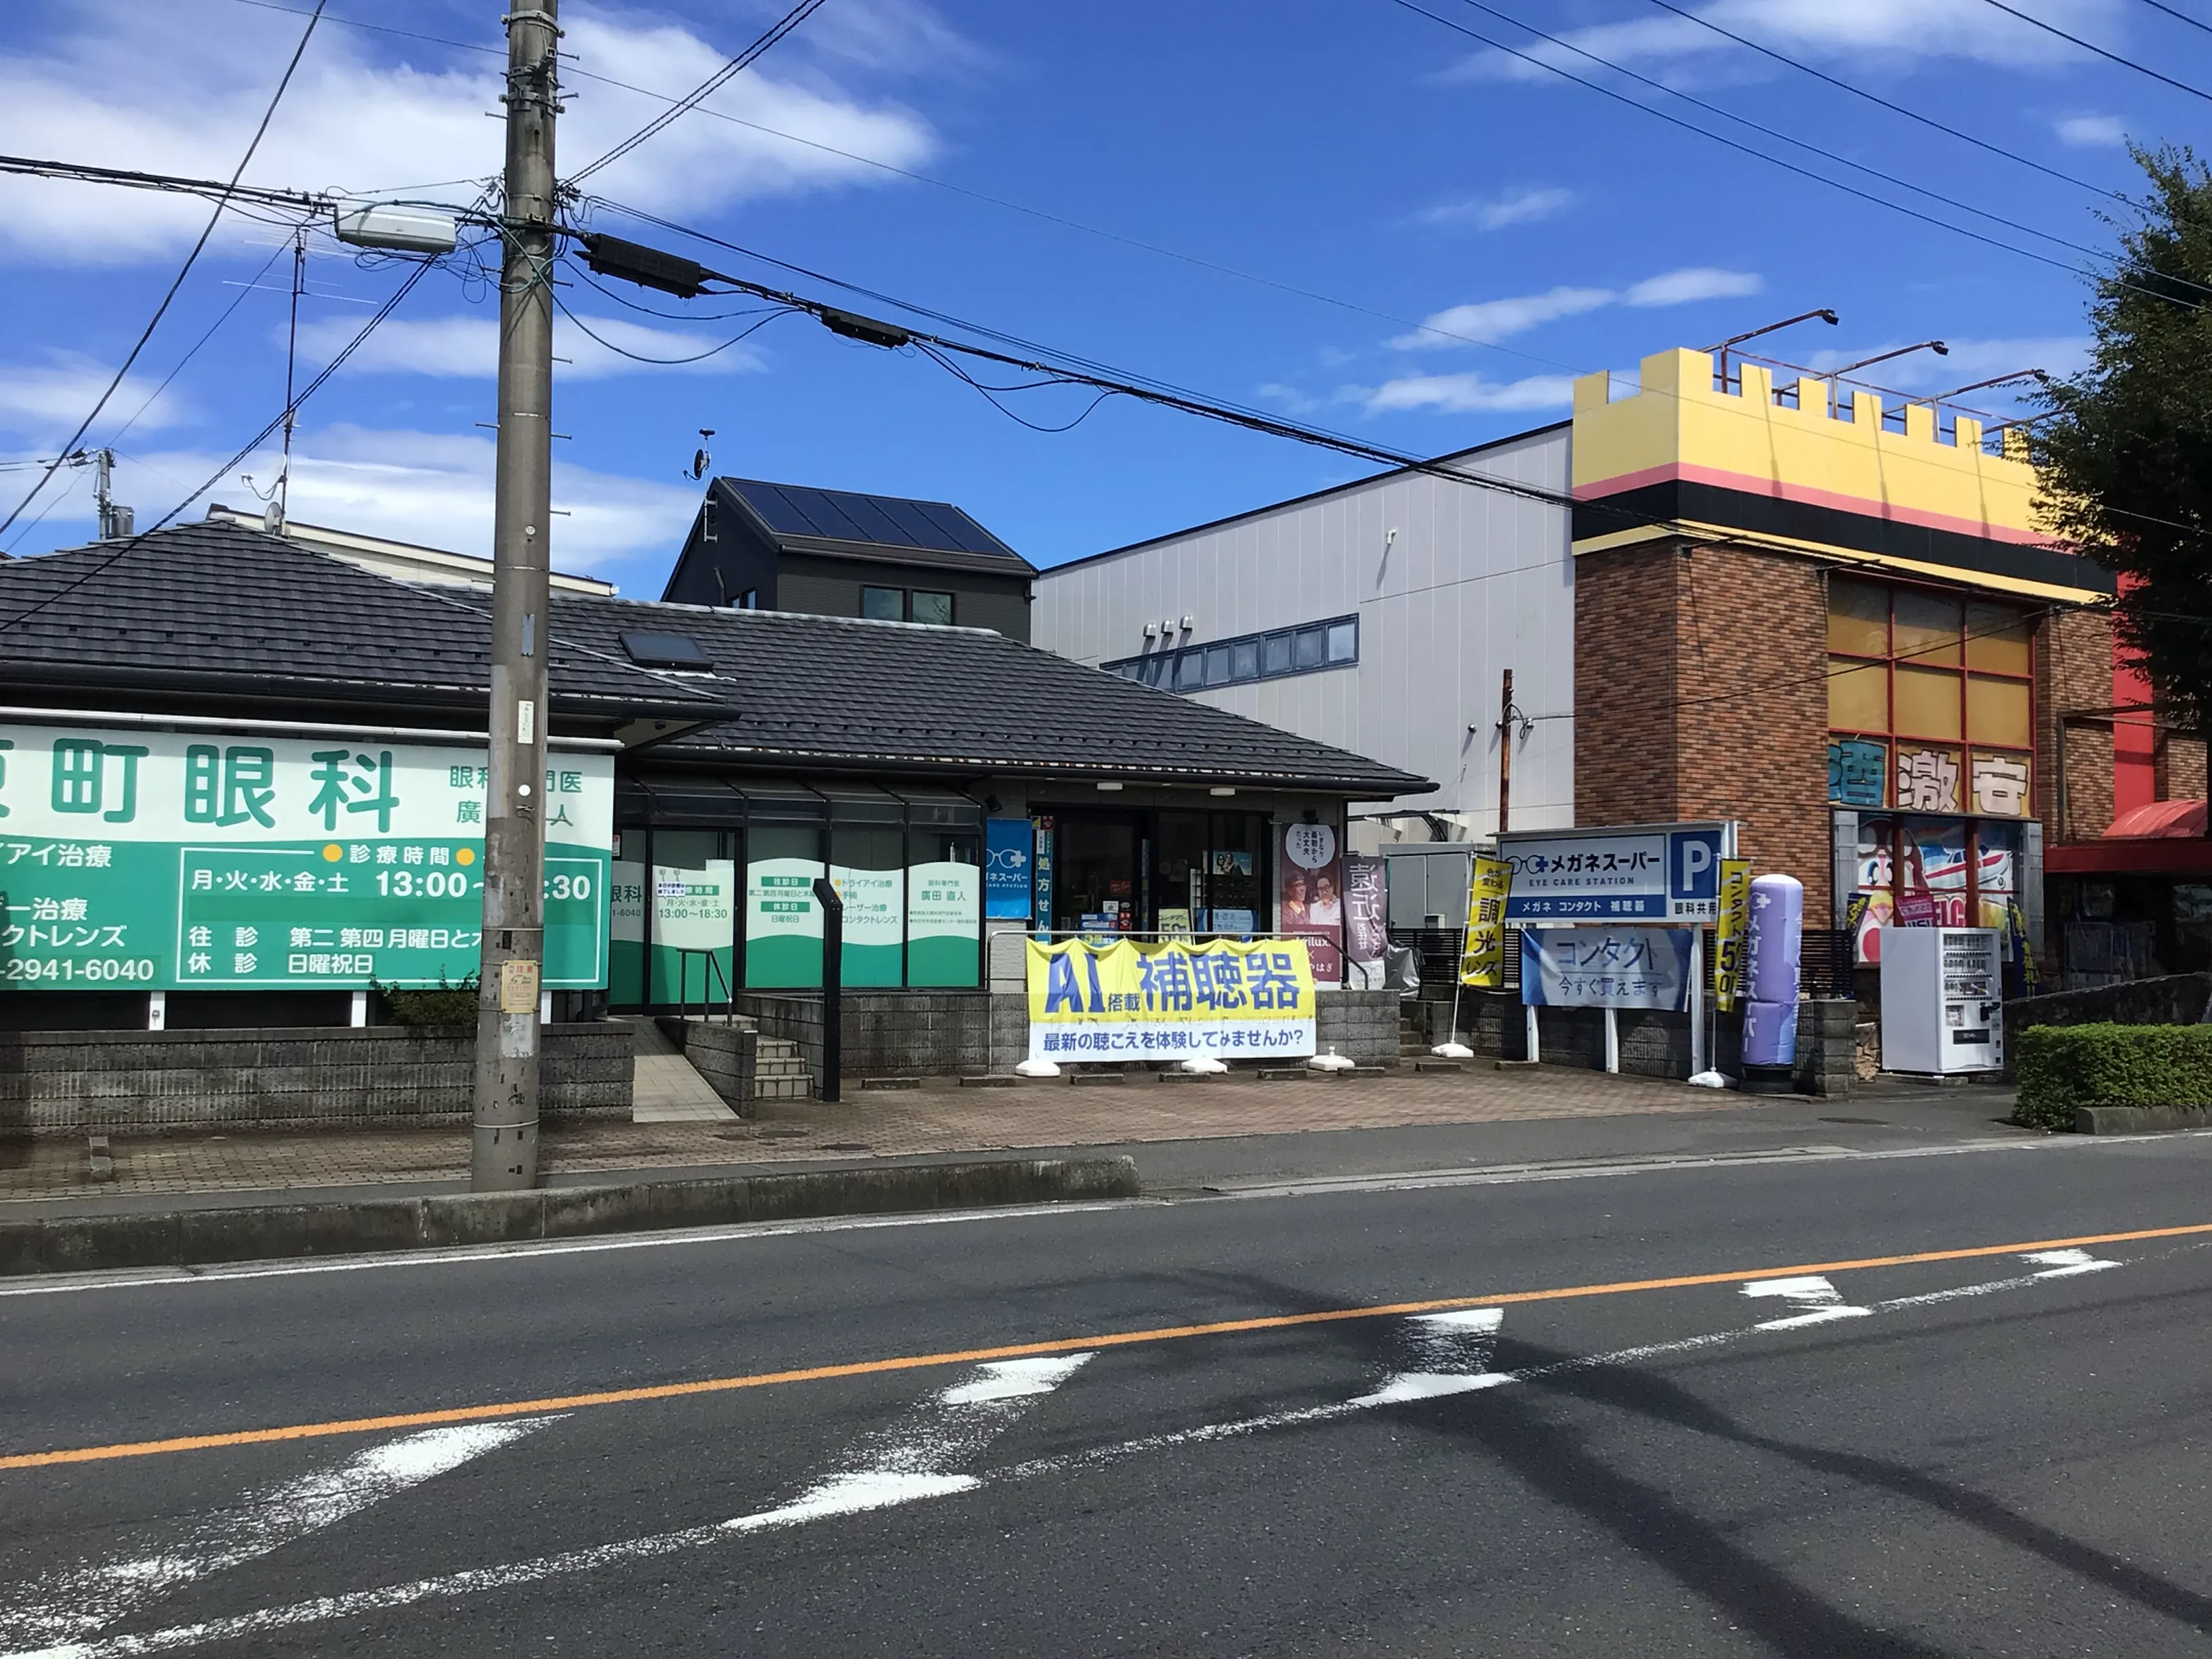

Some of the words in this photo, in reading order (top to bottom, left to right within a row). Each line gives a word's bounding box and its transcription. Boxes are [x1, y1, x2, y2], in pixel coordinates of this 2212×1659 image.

[0, 738, 400, 833] 町眼科
[0, 842, 112, 868] アイ治療
[349, 844, 449, 866] 診療時間
[1551, 853, 1660, 873] メガネスーパー
[1683, 840, 1712, 892] P
[191, 869, 349, 892] 月・火・水・金・土
[842, 879, 893, 887] トライアイ治療
[1529, 878, 1549, 887] EYE
[1553, 878, 1580, 886] CARE
[1586, 877, 1635, 886] STATION
[0, 897, 88, 922] ー治療
[1522, 902, 1552, 912] メガネ
[1559, 901, 1601, 912] コンタクト
[1610, 900, 1645, 913] 補聴器
[1730, 871, 1743, 937] コンタクト
[1475, 897, 1501, 954] 調光
[288, 954, 373, 975] 日曜祝日
[1556, 937, 1658, 970] コンタクト
[1466, 960, 1500, 977] レンズ
[1045, 953, 1105, 1014] AI
[1136, 951, 1300, 1012] 補聴器
[1559, 977, 1663, 998] 今すぐ買えます
[1744, 915, 1762, 1052] メガネスーパー
[1107, 992, 1141, 1012] 搭載
[1044, 1029, 1303, 1052] 最新の聴こえを体験してみませんか?
